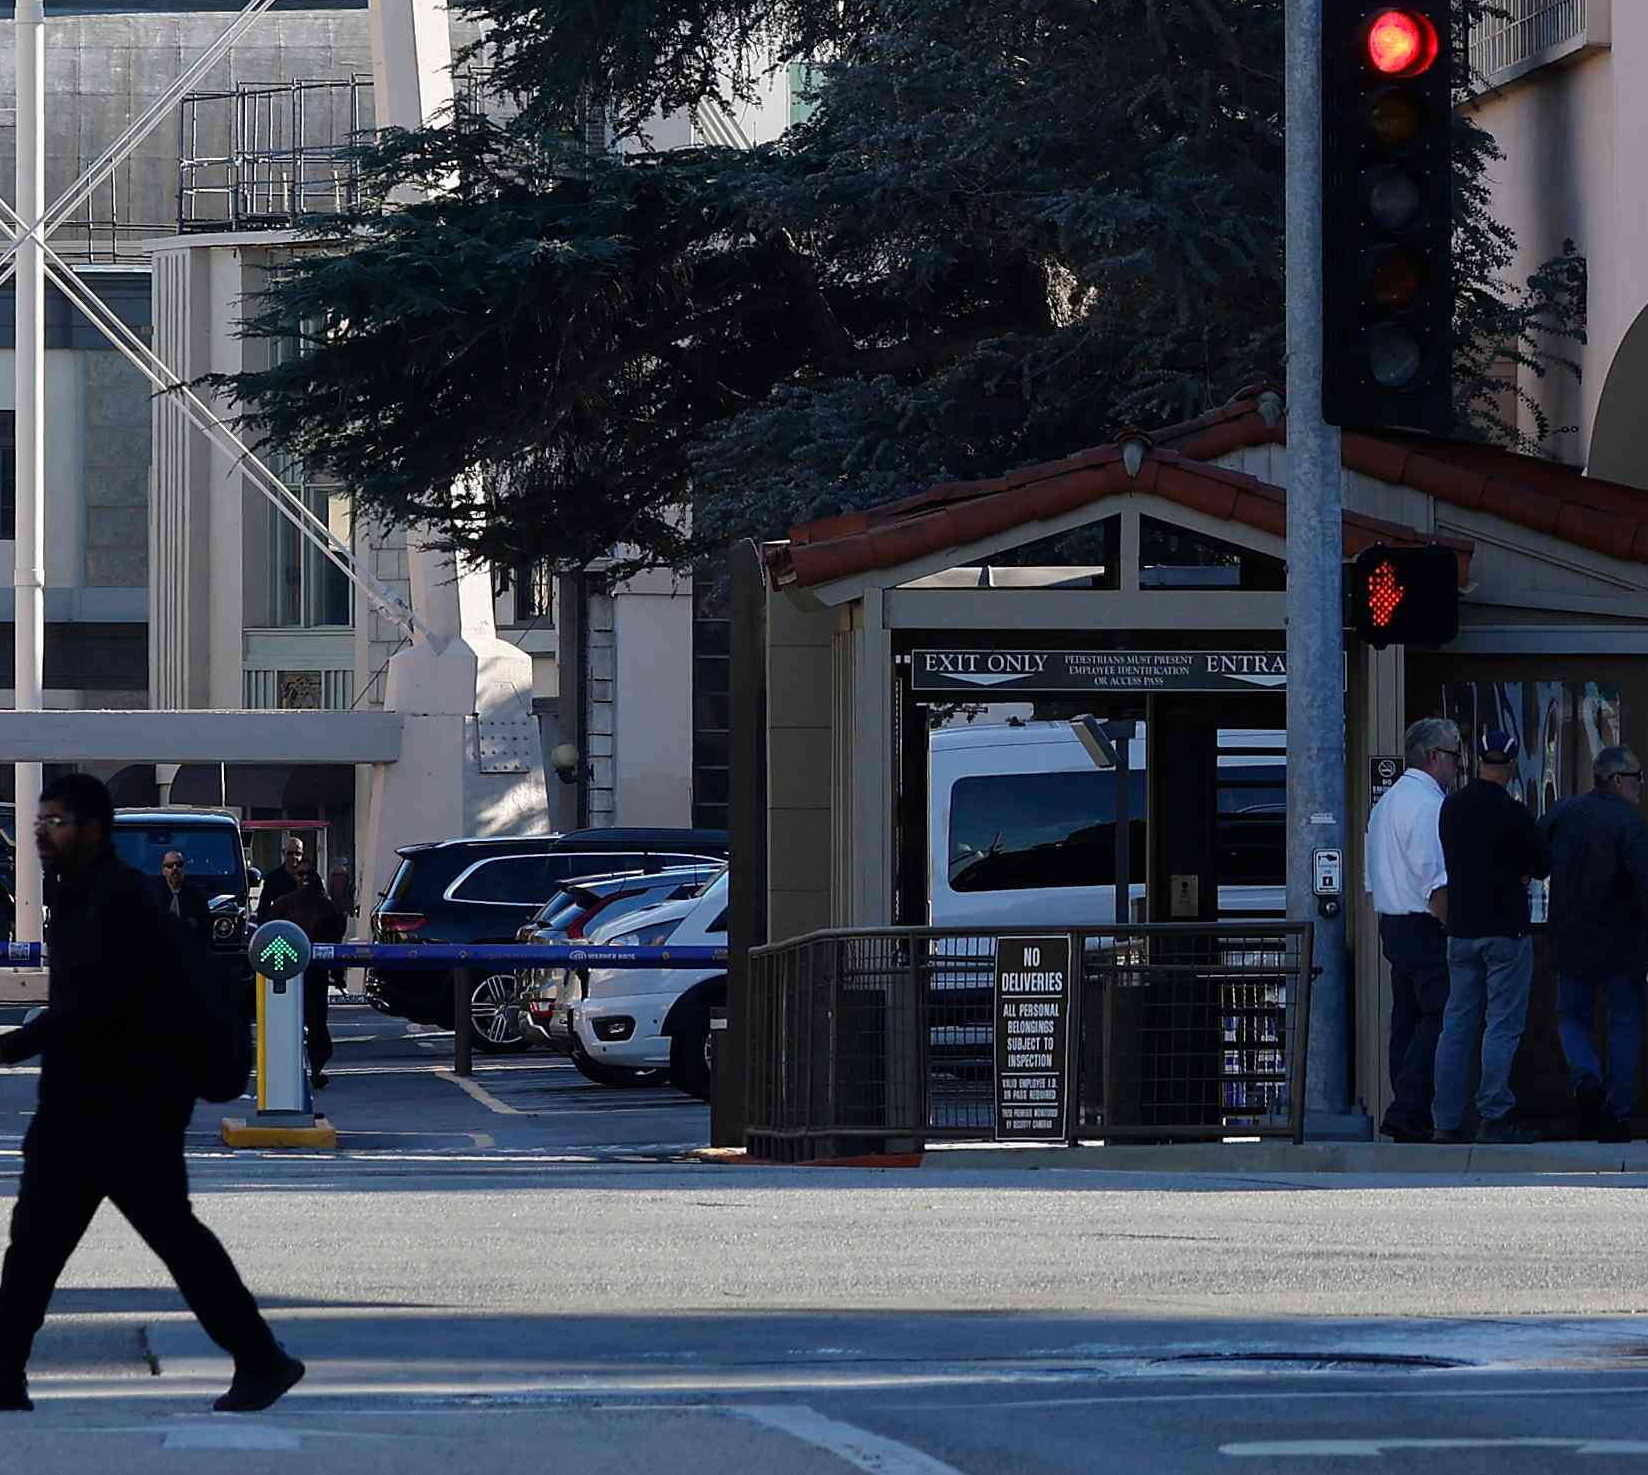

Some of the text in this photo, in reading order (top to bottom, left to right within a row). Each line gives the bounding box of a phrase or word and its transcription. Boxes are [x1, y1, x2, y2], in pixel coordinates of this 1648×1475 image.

[925, 653, 1049, 672] EXIT ONLY
[1064, 655, 1193, 665] PEDESTRIANS MUST PRESENT
[1205, 655, 1287, 673] ENTRA
[1069, 665, 1190, 675] EMPLOYEE IDENTIFICATION
[1093, 675, 1165, 686] OR ACCESS PASS
[1023, 947, 1041, 967] NO
[1001, 971, 1063, 992] DELIVERIES
[1003, 1003, 1060, 1017] ALL PERSONAL
[1007, 1020, 1054, 1034] BELONGINGS
[1007, 1037, 1054, 1051] SUBJECT TO
[1007, 1053, 1053, 1068] INSPECTION
